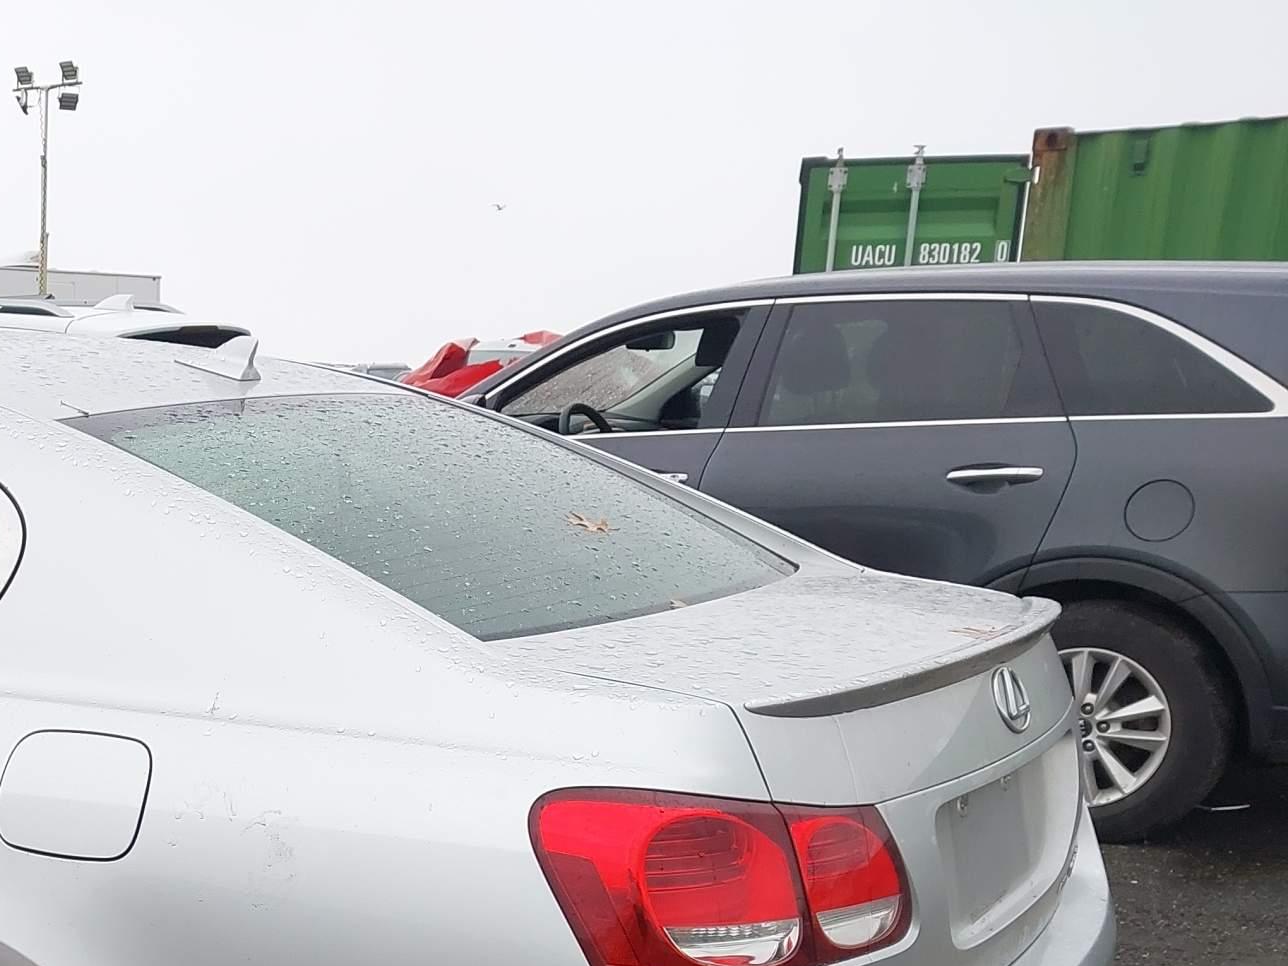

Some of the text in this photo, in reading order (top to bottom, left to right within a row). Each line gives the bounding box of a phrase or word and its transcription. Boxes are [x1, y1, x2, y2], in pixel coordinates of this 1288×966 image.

[851, 241, 1008, 266] UACU 830182 0
